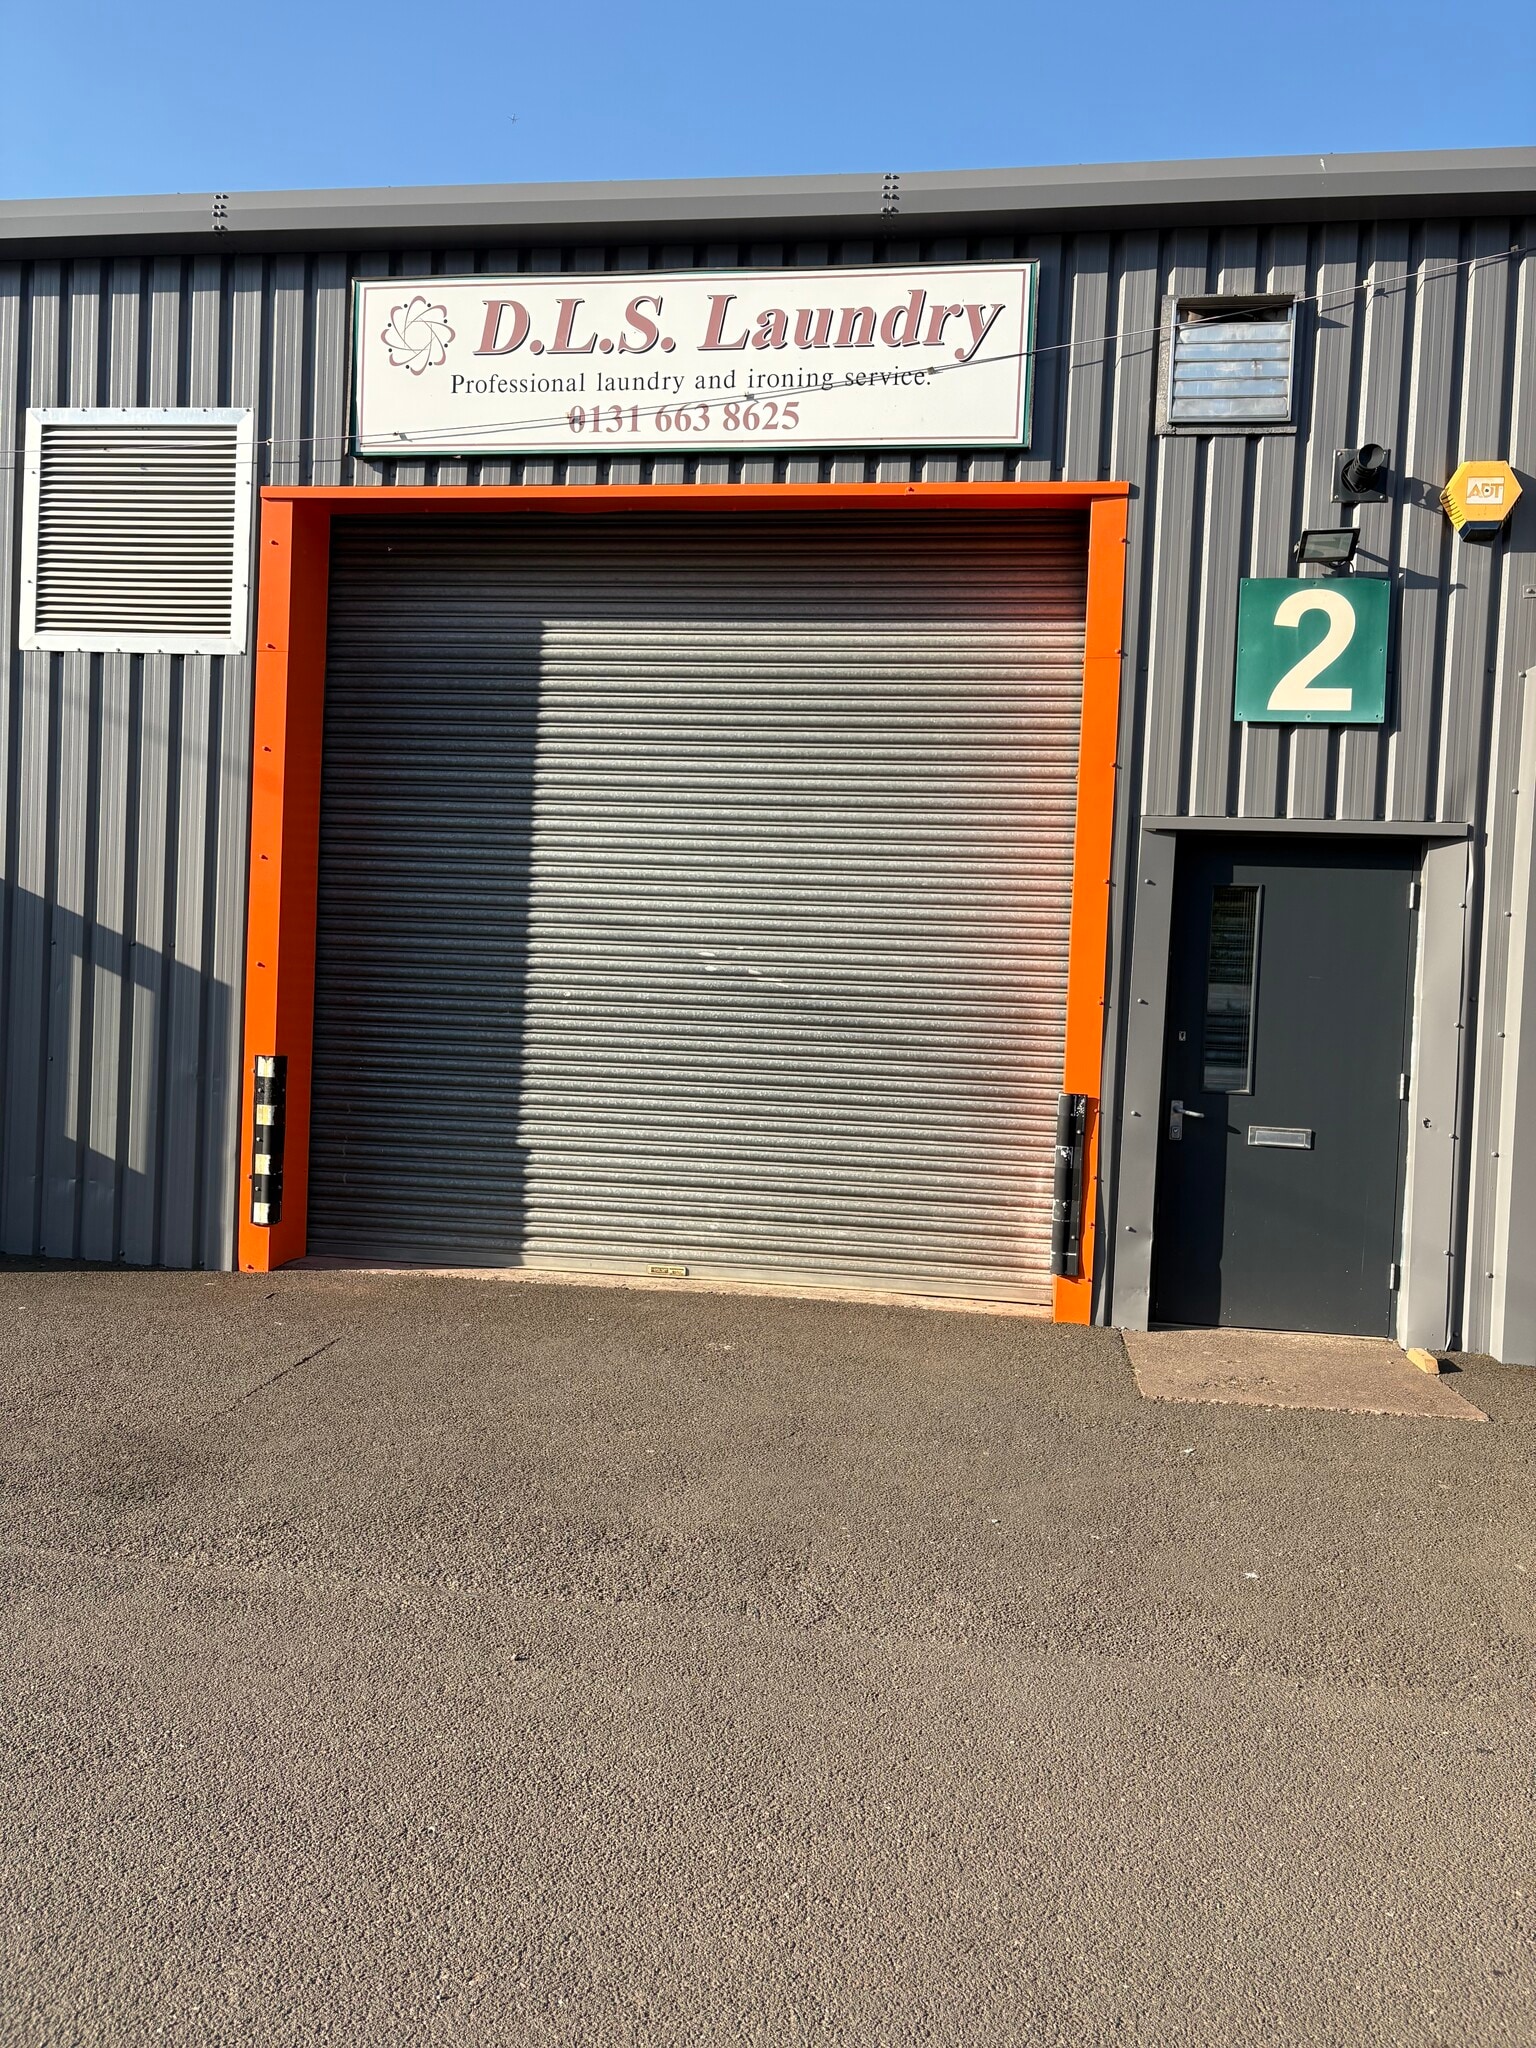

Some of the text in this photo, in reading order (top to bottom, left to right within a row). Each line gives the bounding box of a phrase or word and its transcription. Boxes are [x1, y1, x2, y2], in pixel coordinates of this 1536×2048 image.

[473, 289, 1006, 362] D.L.S. Laundry
[451, 366, 931, 394] Professional laundry and ironing service.
[569, 401, 800, 433] 0131 663 8625
[1466, 483, 1504, 498] ADT
[1267, 588, 1356, 711] 2
